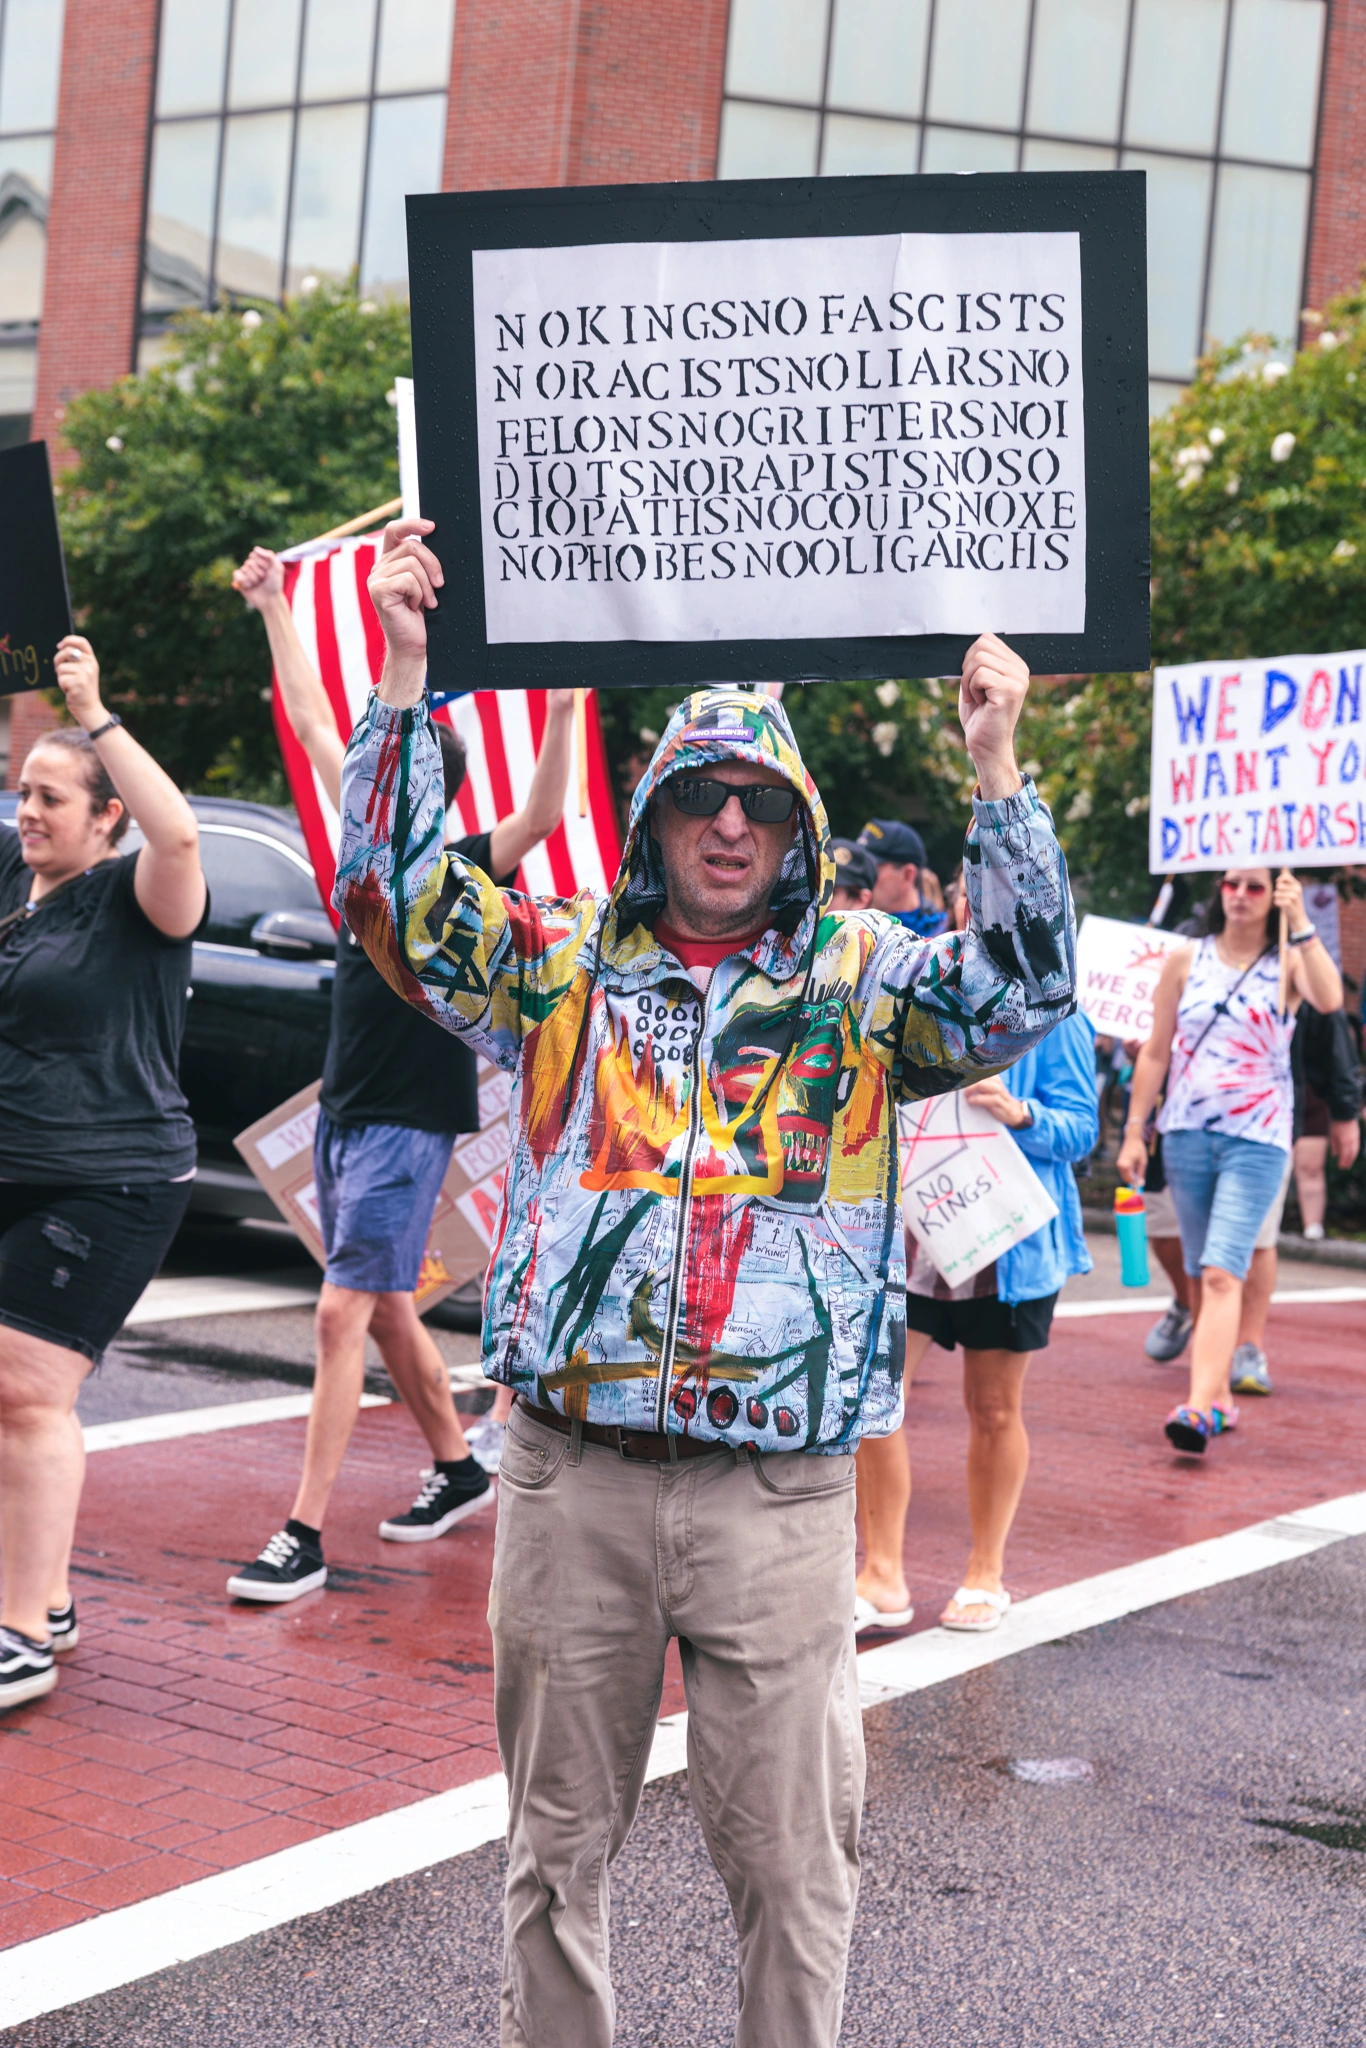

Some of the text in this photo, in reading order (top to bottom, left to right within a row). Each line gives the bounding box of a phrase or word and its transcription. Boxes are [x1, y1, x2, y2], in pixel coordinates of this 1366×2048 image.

[1171, 664, 1363, 744] WE DON
[1170, 740, 1366, 804] WANT YO
[1087, 970, 1126, 995] WE
[916, 1173, 954, 1208] NO
